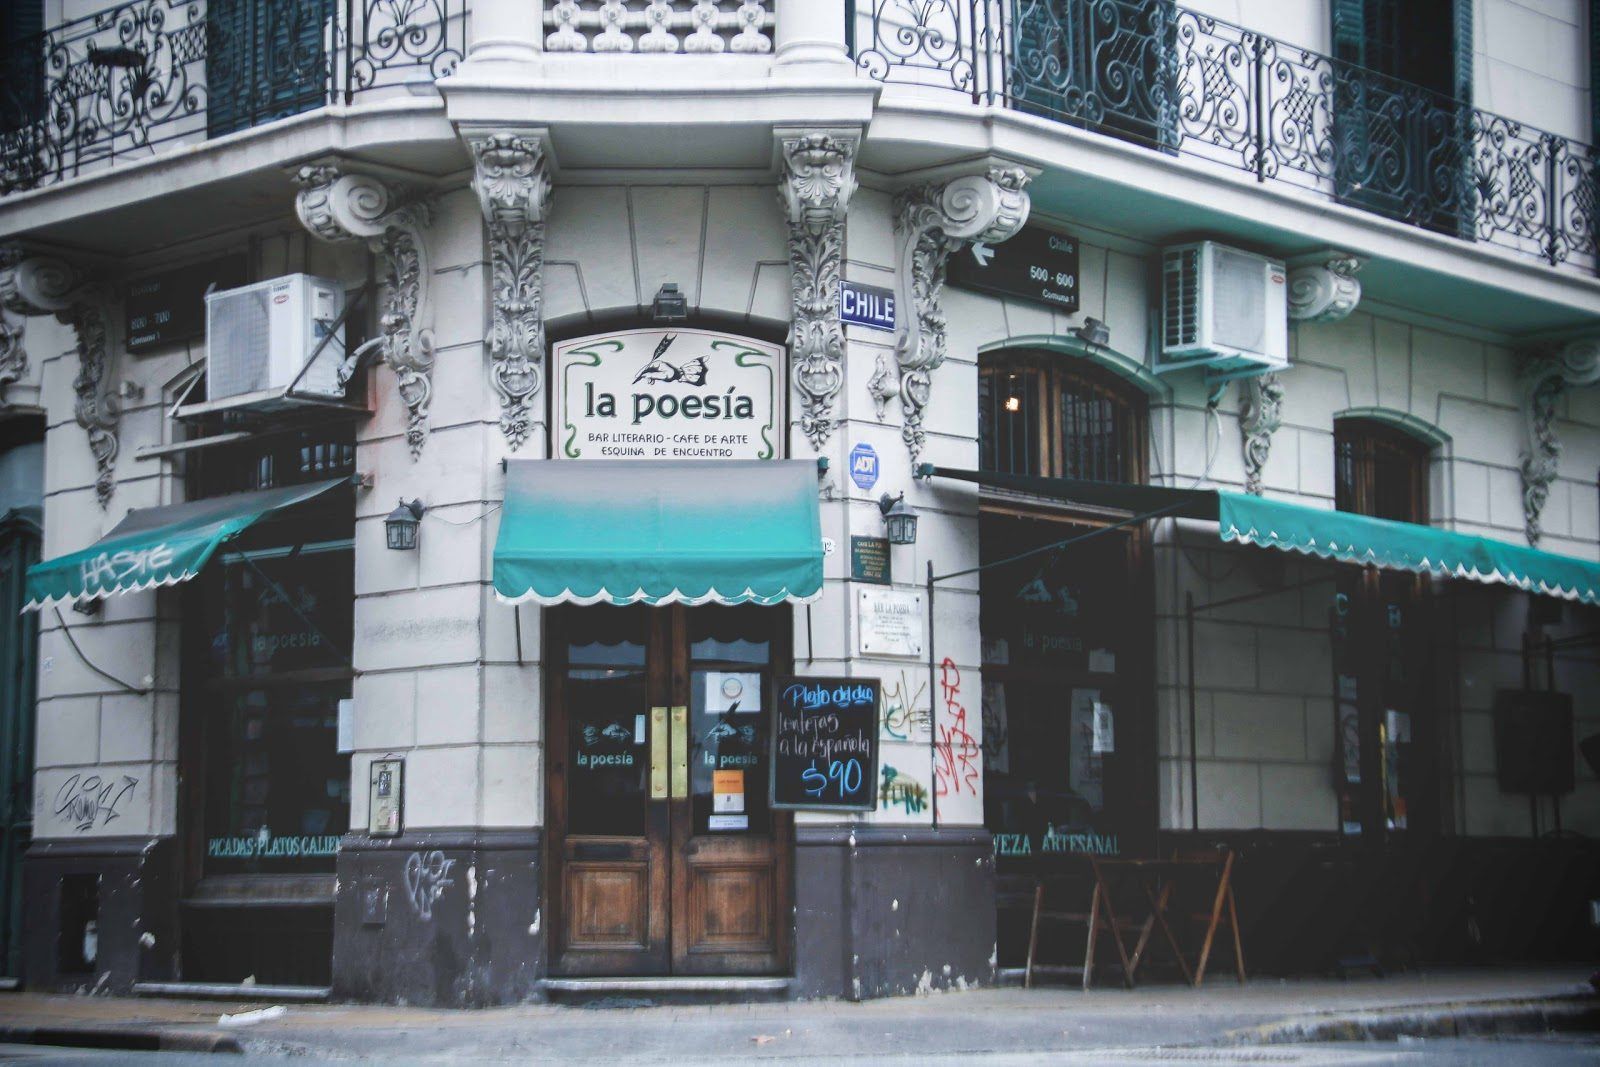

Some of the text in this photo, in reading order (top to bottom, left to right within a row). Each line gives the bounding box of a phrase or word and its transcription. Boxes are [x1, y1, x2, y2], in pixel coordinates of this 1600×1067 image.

[1049, 235, 1073, 254] Chile
[1030, 265, 1048, 281] 500
[1056, 271, 1074, 288] 600
[1042, 288, 1069, 303] Comuna
[842, 289, 895, 322] CHILE
[585, 382, 755, 425] la poesía
[588, 433, 609, 442] BAR
[612, 433, 664, 443] LITERARIO
[673, 434, 700, 443] CAFE
[704, 435, 718, 444] DE
[720, 435, 748, 444] ARTE
[601, 446, 733, 457] ESQUINA DE ENCUENTRO
[855, 456, 875, 474] ADT
[794, 734, 808, 757] la
[577, 751, 588, 765] la
[704, 750, 716, 765] la
[208, 837, 254, 857] PICADAS
[258, 836, 300, 856] PLATOS
[1042, 833, 1121, 855] ARTESANAL
